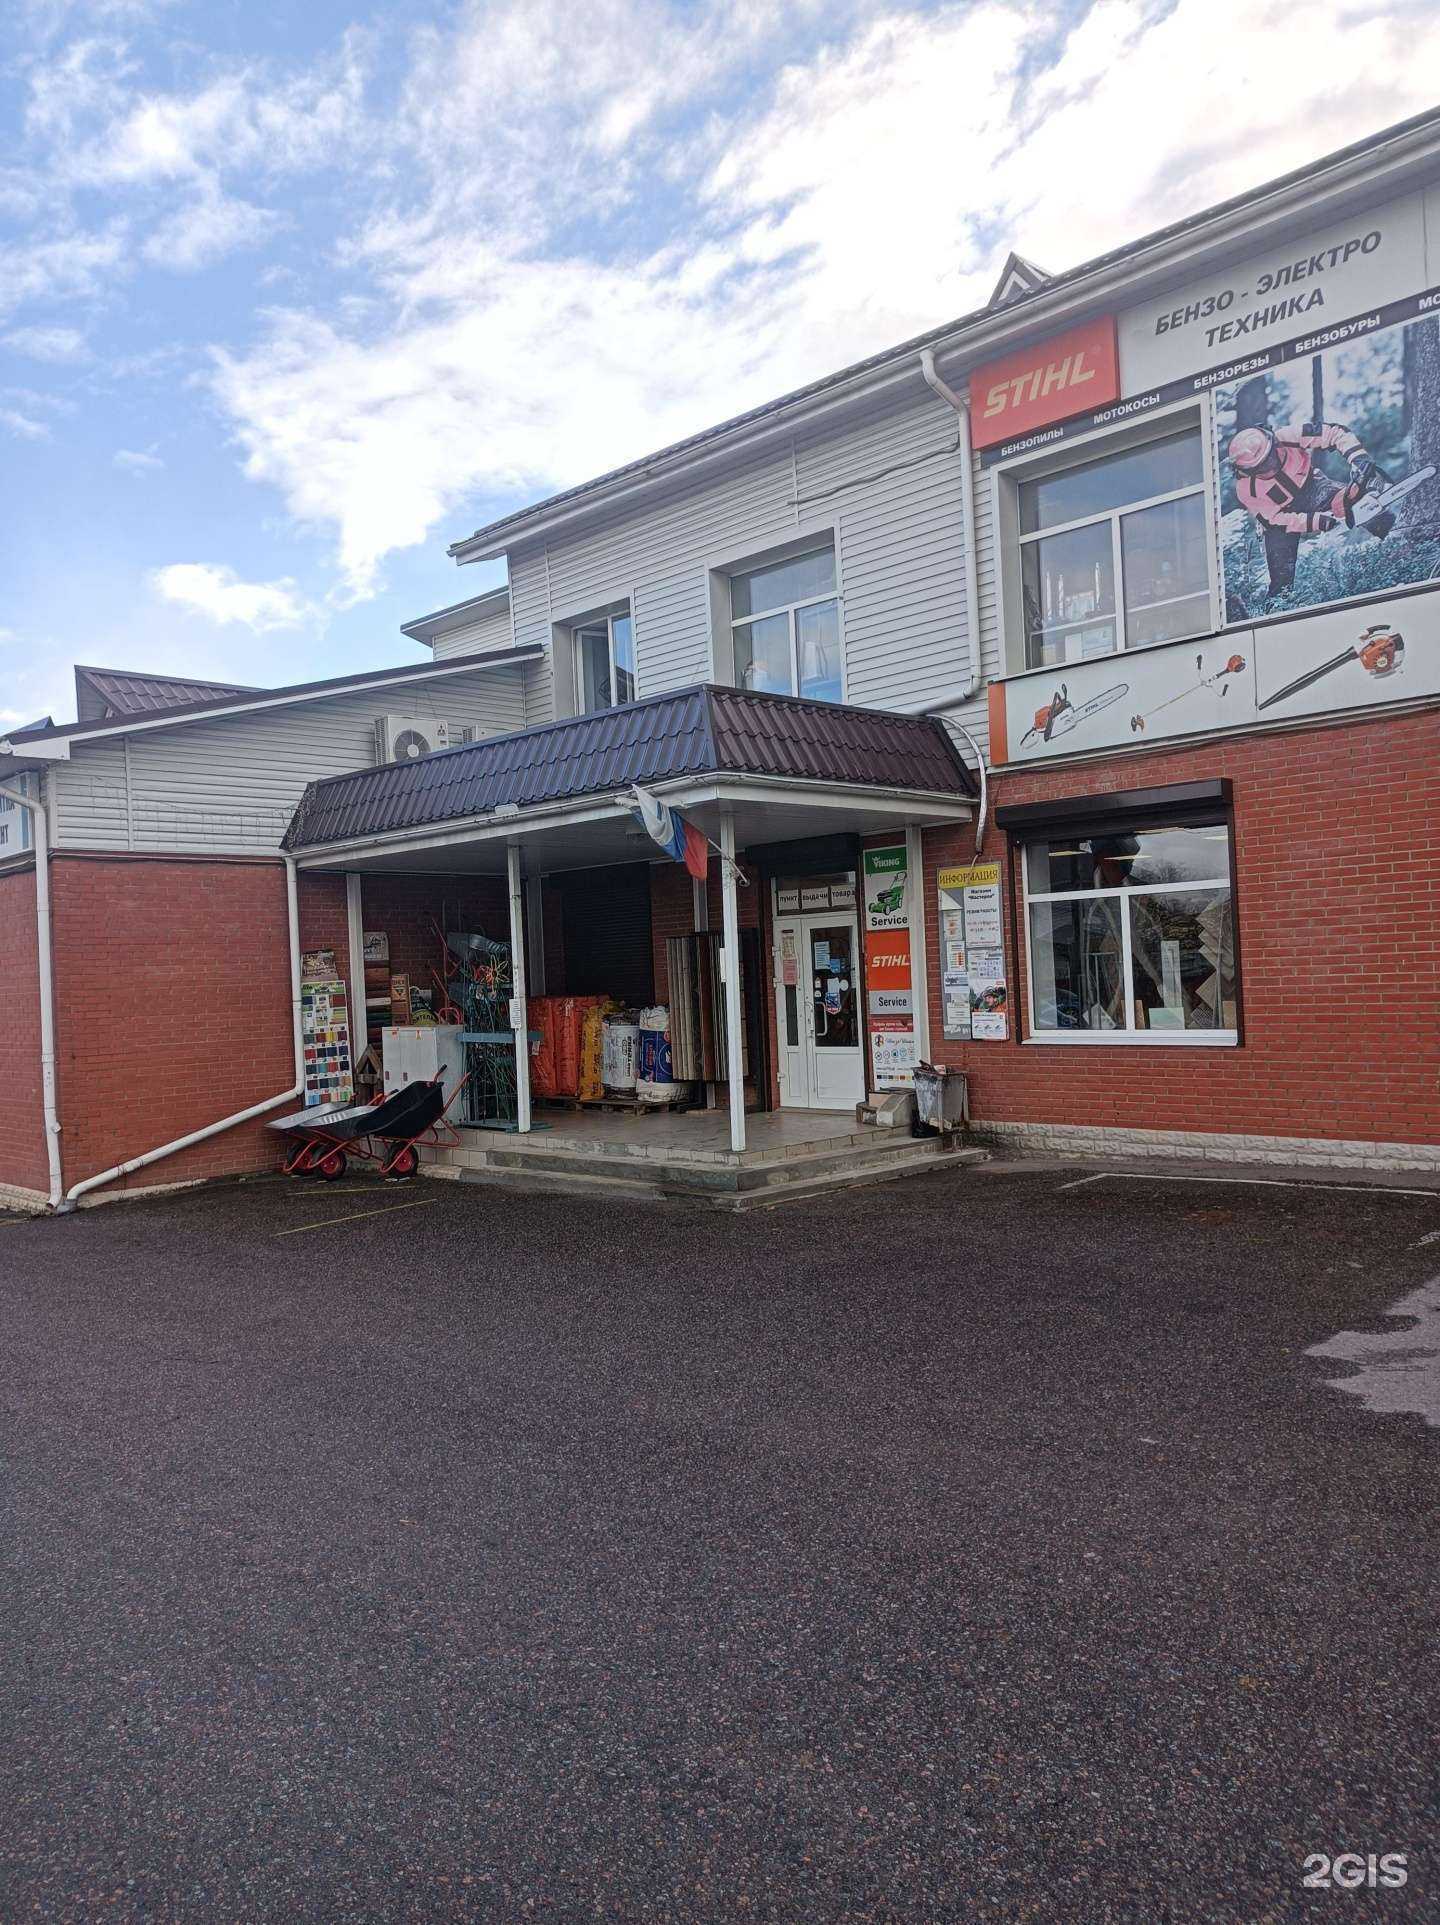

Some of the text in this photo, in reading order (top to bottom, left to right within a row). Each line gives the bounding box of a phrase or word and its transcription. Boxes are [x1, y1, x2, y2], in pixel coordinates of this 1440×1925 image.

[1154, 290, 1234, 336] БЕНЗО
[1256, 231, 1382, 296] ЭЛЕКТРО
[1205, 287, 1325, 348] ТЕХНИКА
[1295, 315, 1381, 353] БЕНЗОБУРЫ
[984, 352, 1095, 418] STIHL
[1193, 353, 1270, 390] БЕНЗОРЕЗЫ
[1093, 393, 1160, 425] МОТОКОСЫ
[1001, 427, 1064, 457] БЕНЗОПИЛЫ
[939, 870, 998, 884] ИНФОРМАЦИЯ
[871, 915, 908, 926] Service
[872, 954, 910, 968] STIHL
[879, 996, 907, 1006] Service
